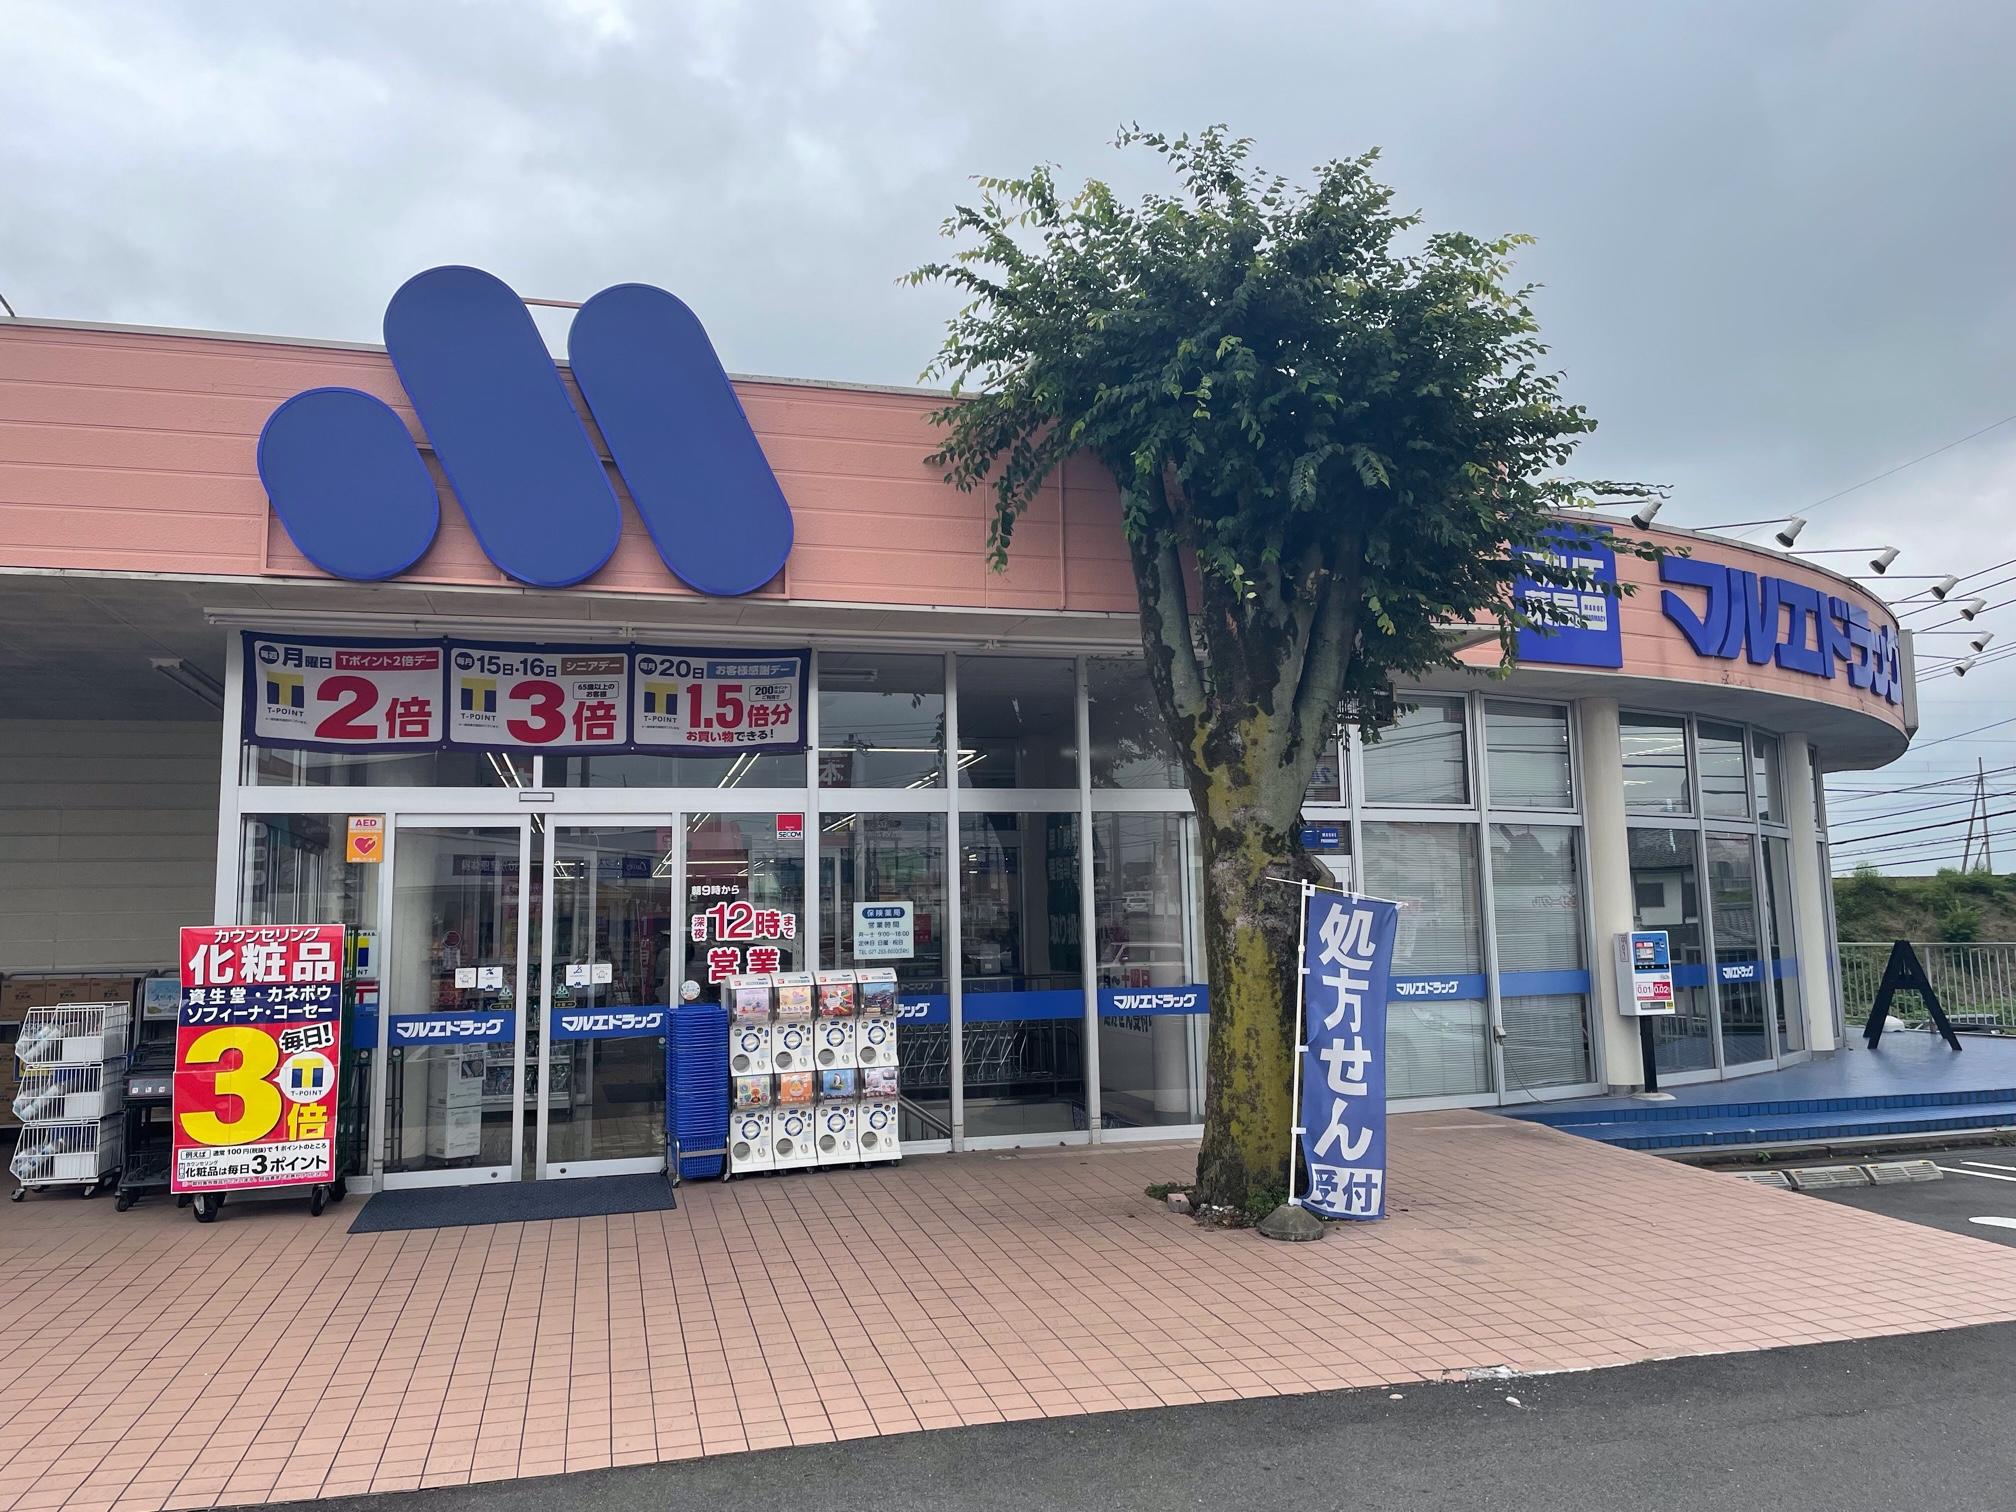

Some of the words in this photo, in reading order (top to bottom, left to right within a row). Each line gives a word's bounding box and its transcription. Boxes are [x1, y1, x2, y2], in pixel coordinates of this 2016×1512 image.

[1659, 555, 1900, 705] マルエドラッグ
[282, 647, 333, 669] 月曜日
[339, 655, 437, 667] Tポイント2倍デー
[565, 659, 621, 672] シニアデー
[659, 658, 705, 679] 20日
[755, 685, 774, 696] 200
[267, 706, 304, 717] T-POINT
[460, 712, 497, 722] T-POINT
[644, 715, 678, 724] T-POINT
[355, 819, 377, 827] AED
[691, 885, 740, 895] 朝9時から
[693, 915, 706, 940] 深夜
[706, 902, 780, 940] 12時
[783, 914, 795, 938] まで
[866, 908, 902, 918] 保険薬局
[868, 921, 900, 929] 営業時間
[214, 927, 321, 944] カウンセリング
[188, 942, 336, 985] 化粧品
[709, 947, 779, 982] 営業
[189, 985, 332, 1006] 資生堂・カネボウ
[1396, 981, 1459, 996] マルエドラッグ
[1113, 993, 1198, 1011] マルエドラッグ
[187, 1003, 333, 1024] ソフィーナ・コーセー
[562, 1012, 664, 1032] マルエドラッグ
[396, 1018, 505, 1038] マルエドラッグ
[1313, 902, 1376, 1163] 処方せん
[281, 1024, 333, 1051] 毎日!
[291, 1089, 323, 1097] T-POINT
[185, 1151, 206, 1160] 例えば
[1313, 1169, 1378, 1213] 受付
